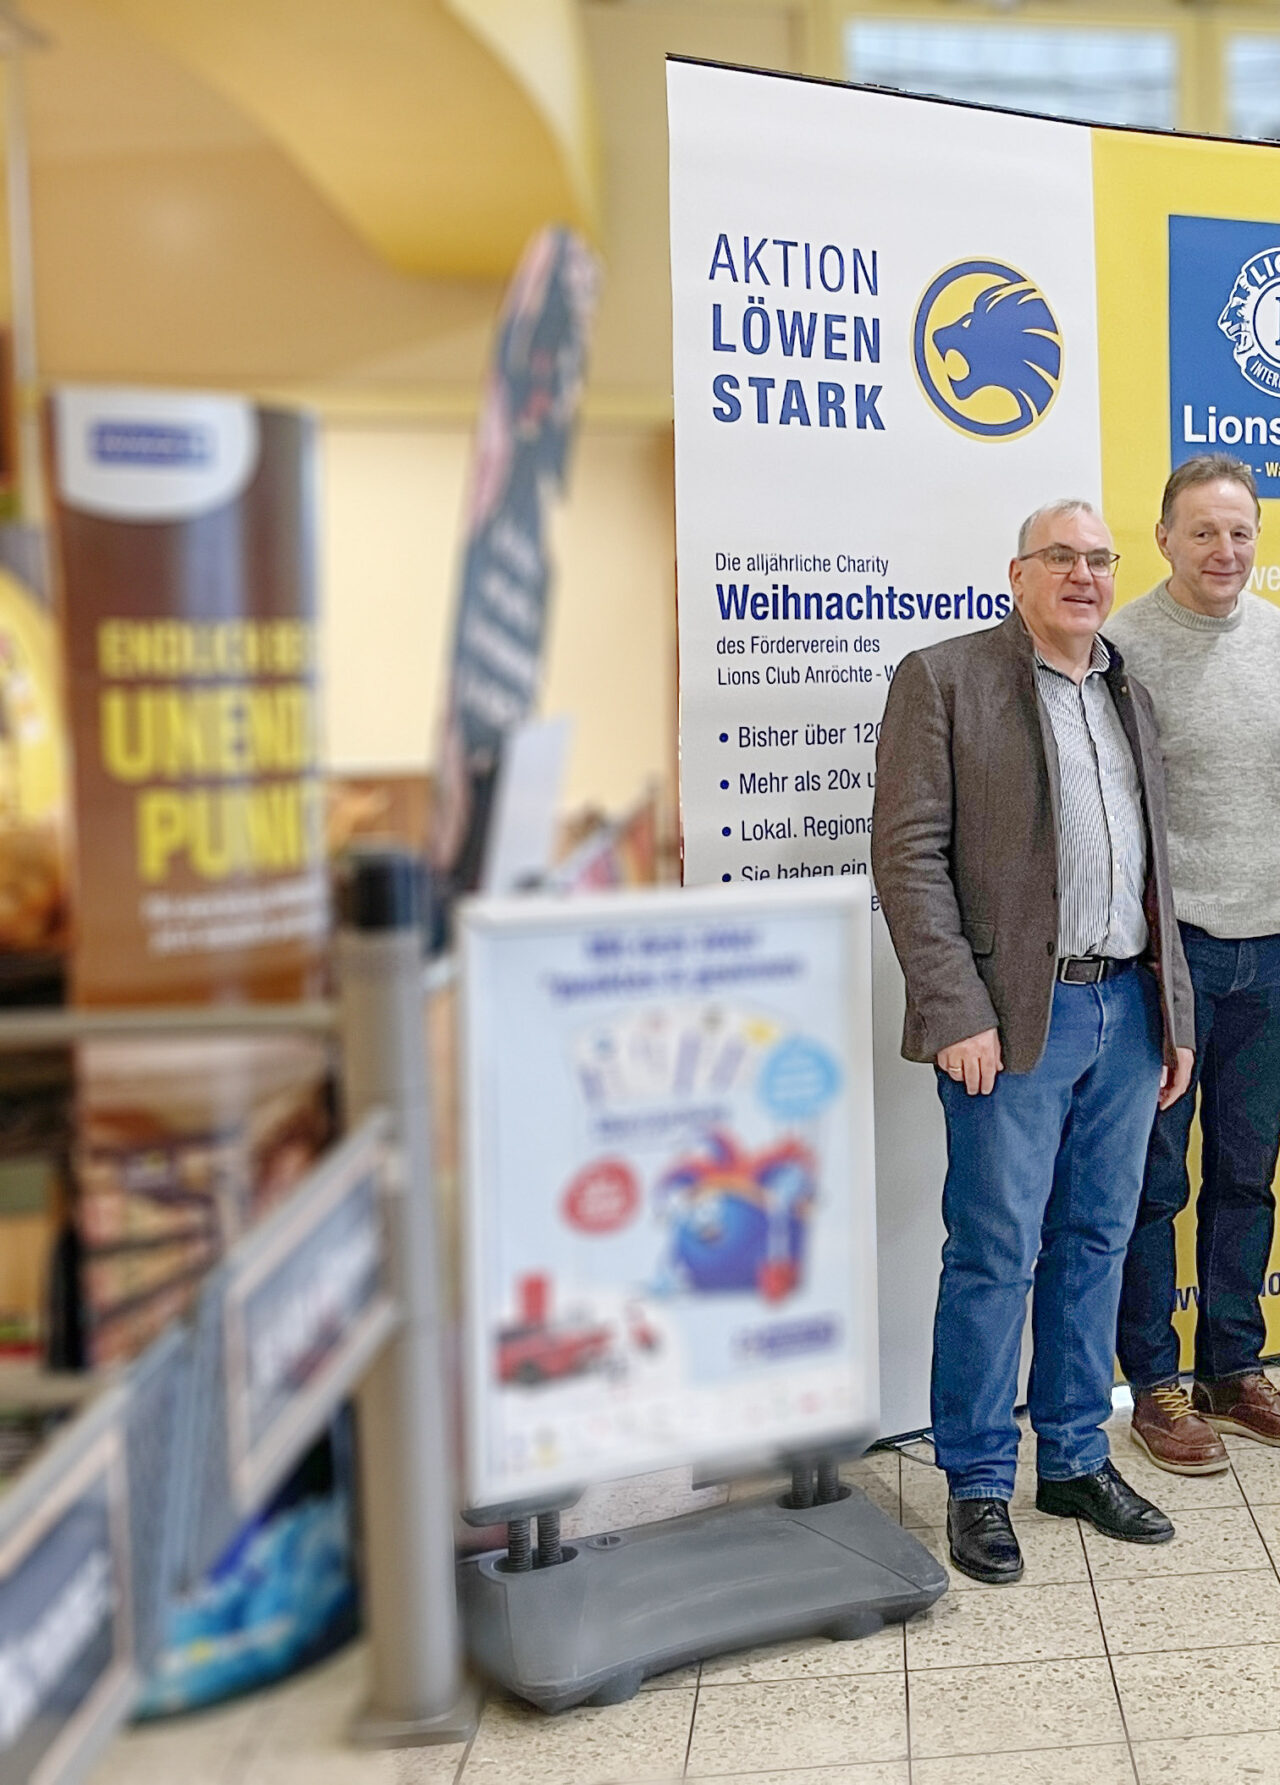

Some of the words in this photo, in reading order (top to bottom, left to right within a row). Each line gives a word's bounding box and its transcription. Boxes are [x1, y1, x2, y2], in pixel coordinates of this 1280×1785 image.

[709, 233, 878, 296] AKTION
[712, 296, 880, 363] LÖWEN
[712, 374, 886, 430] STARK
[716, 552, 741, 571] Die
[746, 553, 831, 576] alljährliche
[836, 554, 889, 577] Charity
[716, 583, 1011, 621] Weihnachtsverlos
[717, 636, 745, 654] des
[751, 635, 848, 655] Förderverein
[853, 635, 880, 653] des
[717, 668, 760, 686] Lions
[766, 666, 800, 685] Club
[805, 664, 872, 684] Anröchte
[739, 725, 798, 748] Bisher
[805, 724, 846, 745] über
[739, 772, 788, 794] Mehr
[794, 770, 821, 792] als
[828, 769, 861, 790] 20x
[741, 817, 797, 841] Lokal.
